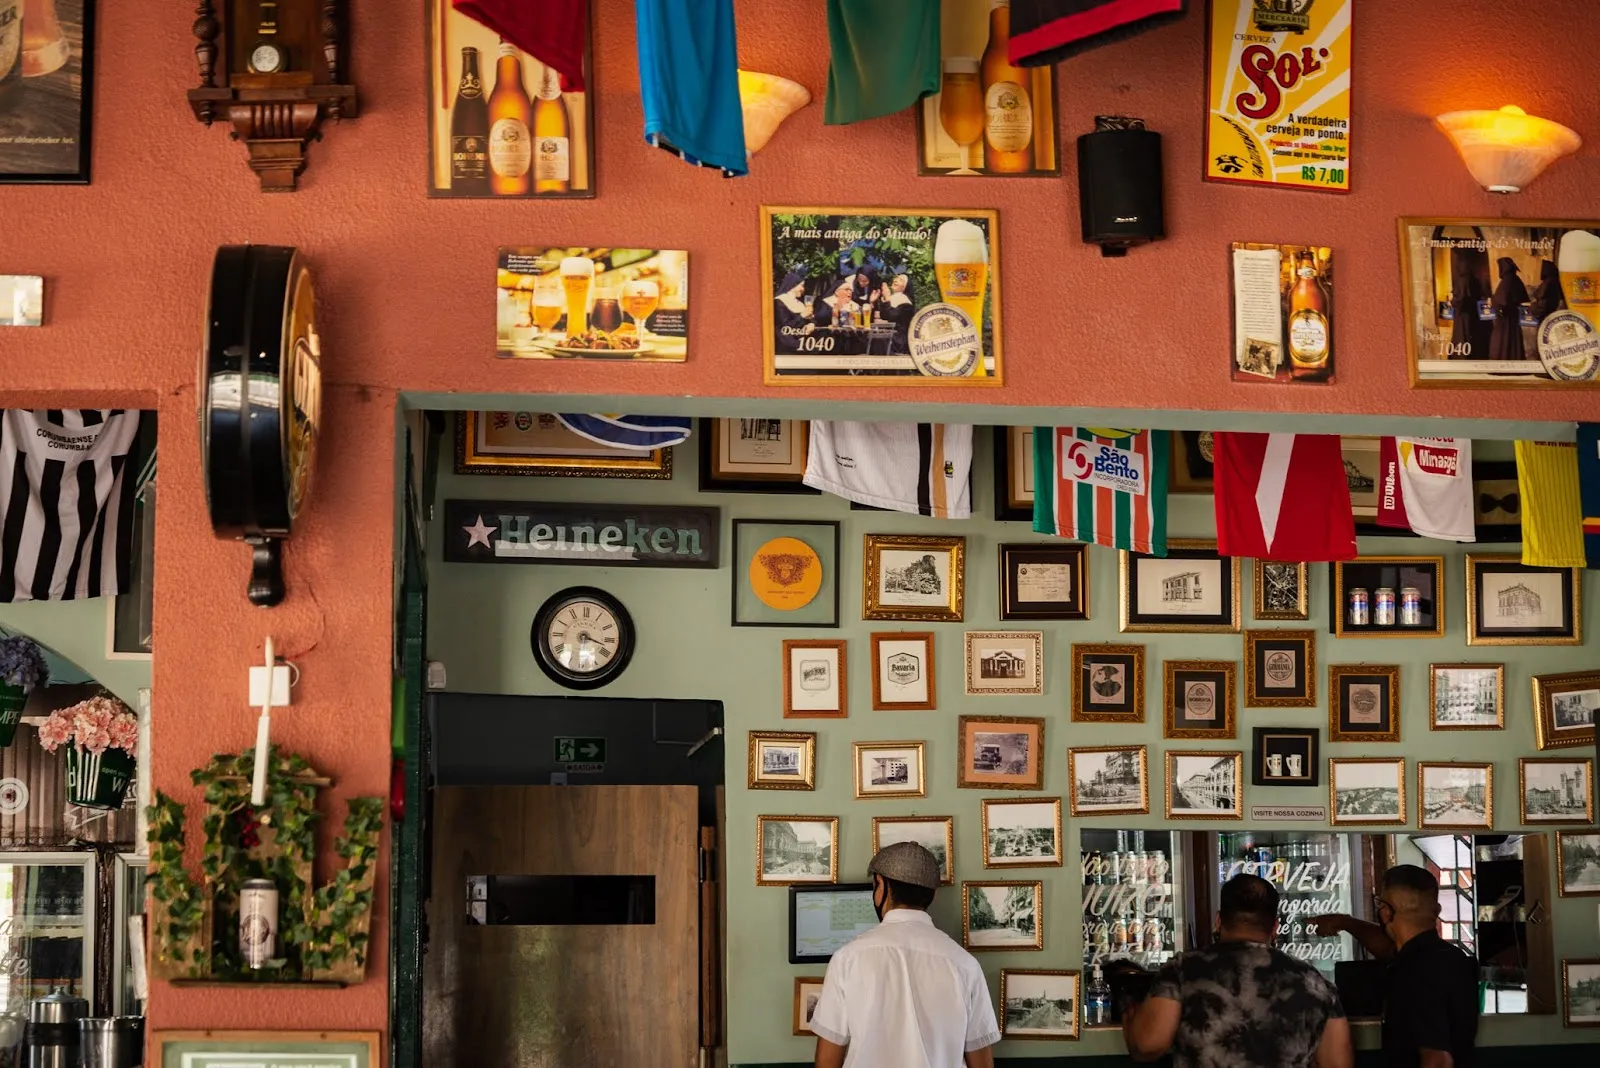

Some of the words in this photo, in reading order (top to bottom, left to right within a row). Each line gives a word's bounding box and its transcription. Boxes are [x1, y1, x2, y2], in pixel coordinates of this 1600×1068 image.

[1258, 13, 1306, 24] MERCEARIA
[1234, 33, 1277, 44] CERVEZA
[1288, 113, 1294, 123] A
[1298, 115, 1347, 128] verdadeira
[1266, 124, 1300, 136] cerveja
[1304, 128, 1315, 137] no
[1318, 130, 1346, 140] ponto.
[1302, 165, 1315, 181] R$
[1320, 167, 1344, 184] 7,00
[778, 226, 790, 239] A
[794, 226, 821, 239] mais
[824, 227, 862, 242] antiga
[866, 226, 880, 240] do
[884, 227, 932, 240] Mundo!
[1431, 237, 1455, 249] mais
[1458, 237, 1492, 252] antiga
[1511, 237, 1555, 250] Mundo!
[797, 336, 835, 351] 1040
[915, 333, 976, 356] Weihenstephan
[1438, 341, 1471, 356] 1040
[37, 428, 93, 443] CORUMBAENSE
[1101, 447, 1128, 467] São
[1095, 457, 1138, 480] Bento
[1094, 473, 1139, 487] INCORPORADORA
[1385, 462, 1396, 495] Wilson
[497, 515, 702, 555] Heineken
[891, 663, 916, 671] Bavaria
[1278, 892, 1342, 923] ngorda
[1082, 942, 1164, 971] ERVEJA
[1280, 942, 1343, 961] CIDADE
